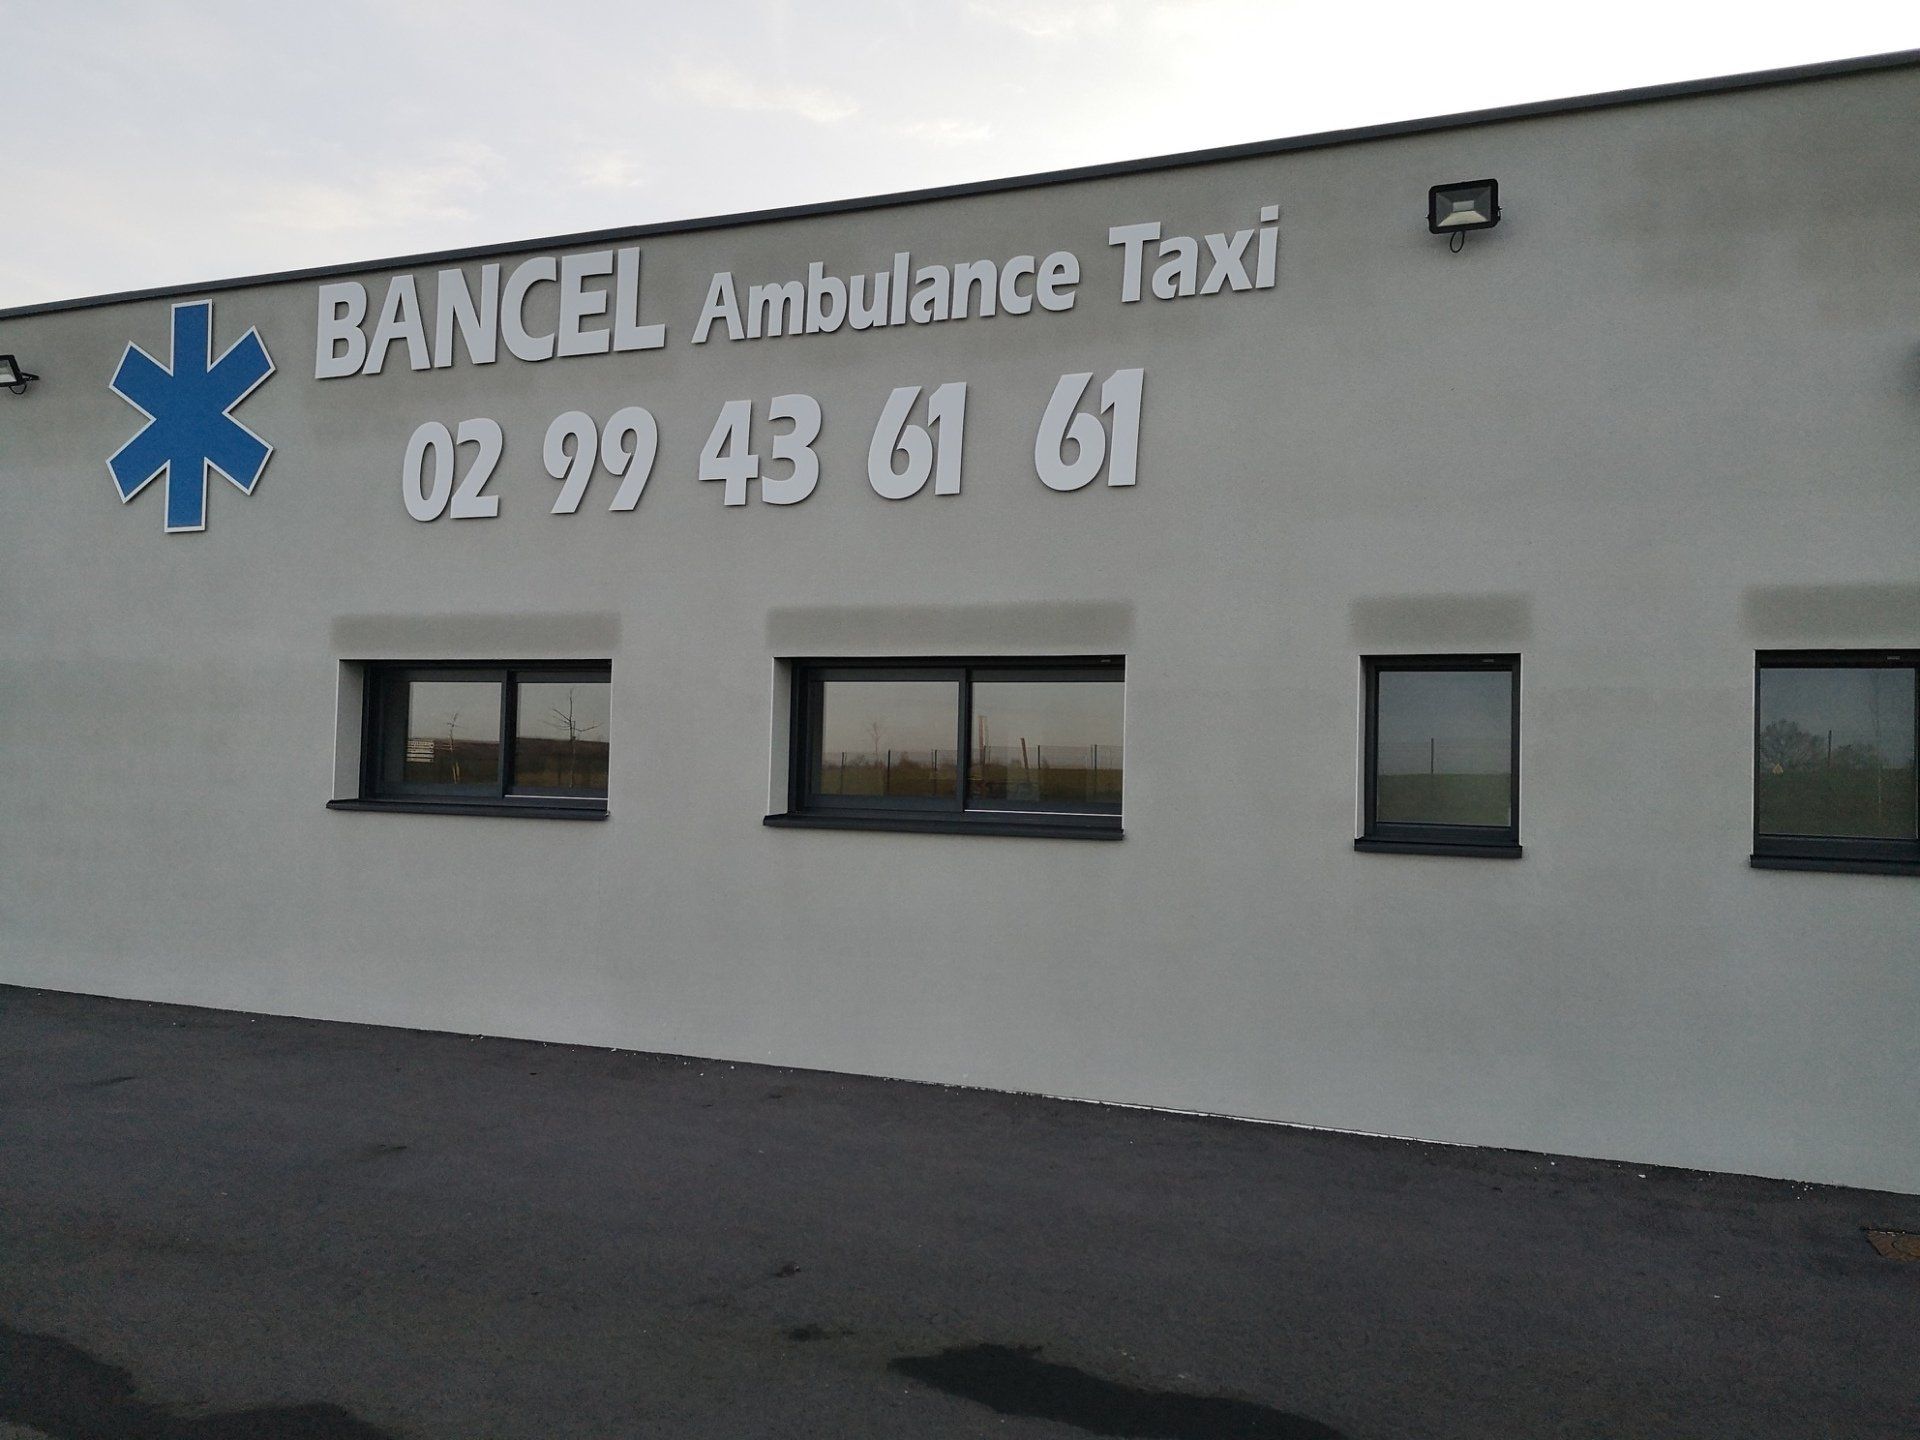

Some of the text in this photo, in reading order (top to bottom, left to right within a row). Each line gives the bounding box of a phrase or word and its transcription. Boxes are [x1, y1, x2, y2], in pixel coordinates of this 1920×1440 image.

[314, 204, 1280, 380] BANCEL Ambulance Taxi
[402, 368, 1145, 522] 02 99 43 61 61
